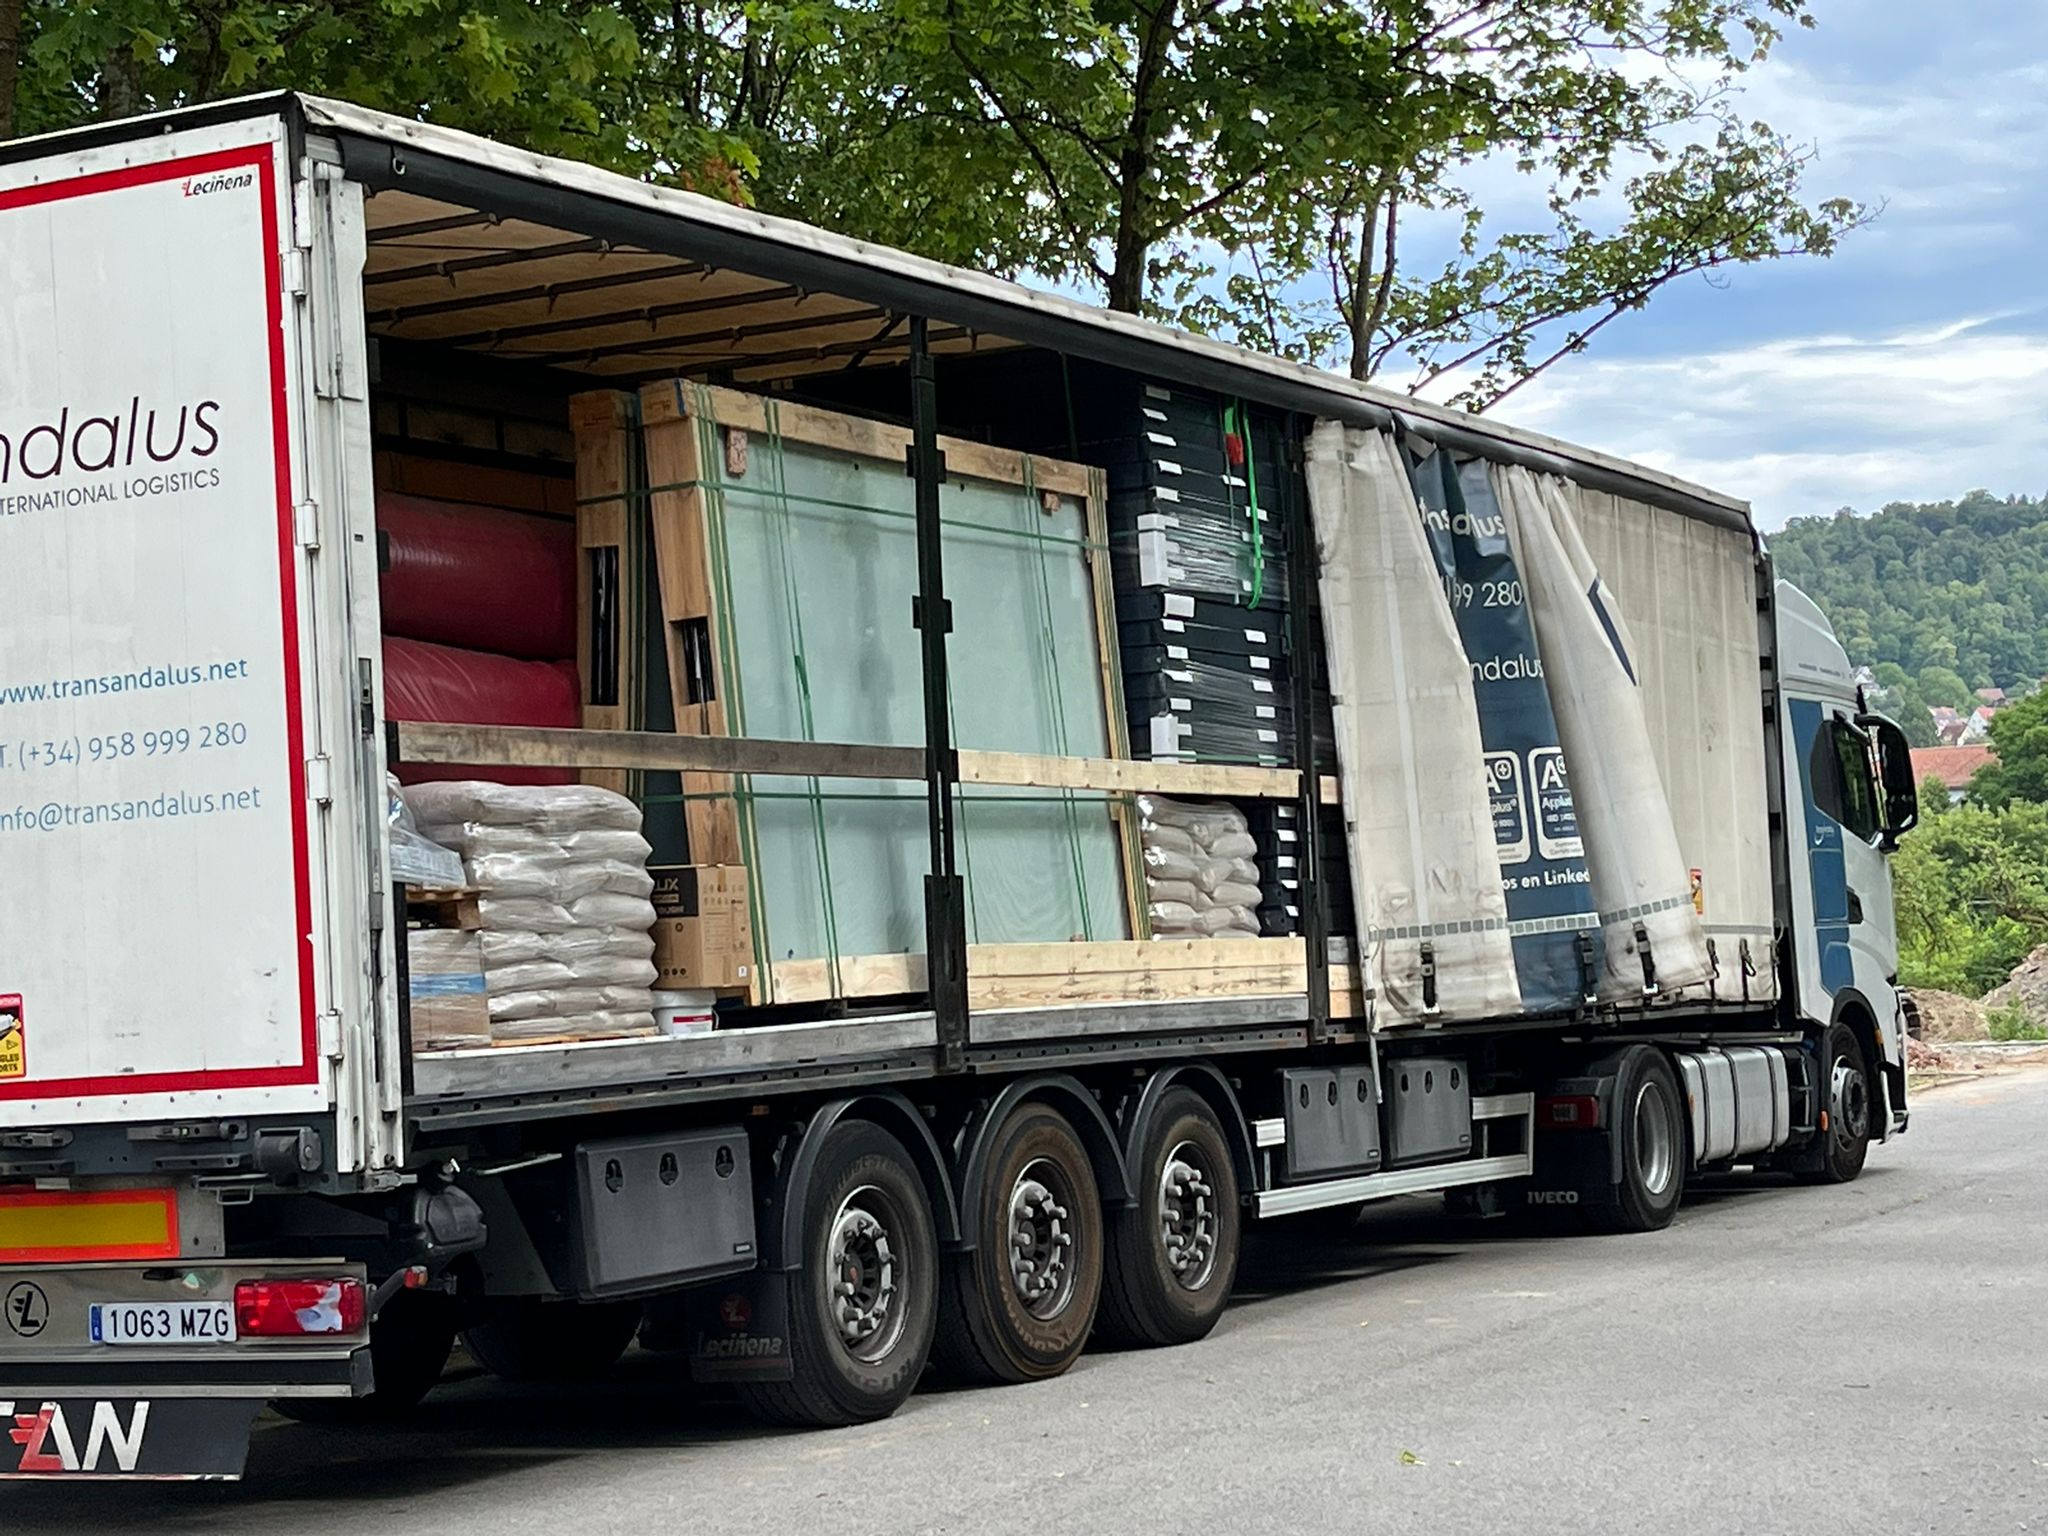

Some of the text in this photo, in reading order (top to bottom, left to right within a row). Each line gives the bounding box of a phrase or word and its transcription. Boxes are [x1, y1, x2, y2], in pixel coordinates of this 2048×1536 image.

[0, 396, 220, 483] dalus
[124, 467, 220, 499] LOGISTICS
[1481, 580, 1523, 607] 280
[19, 736, 81, 771] (+34)
[88, 732, 135, 762] 958
[143, 728, 190, 756] 999
[199, 722, 247, 748] 280
[1521, 875, 1541, 888] en
[1527, 1191, 1579, 1204] IVECO
[110, 1309, 229, 1338] 1063 MZG
